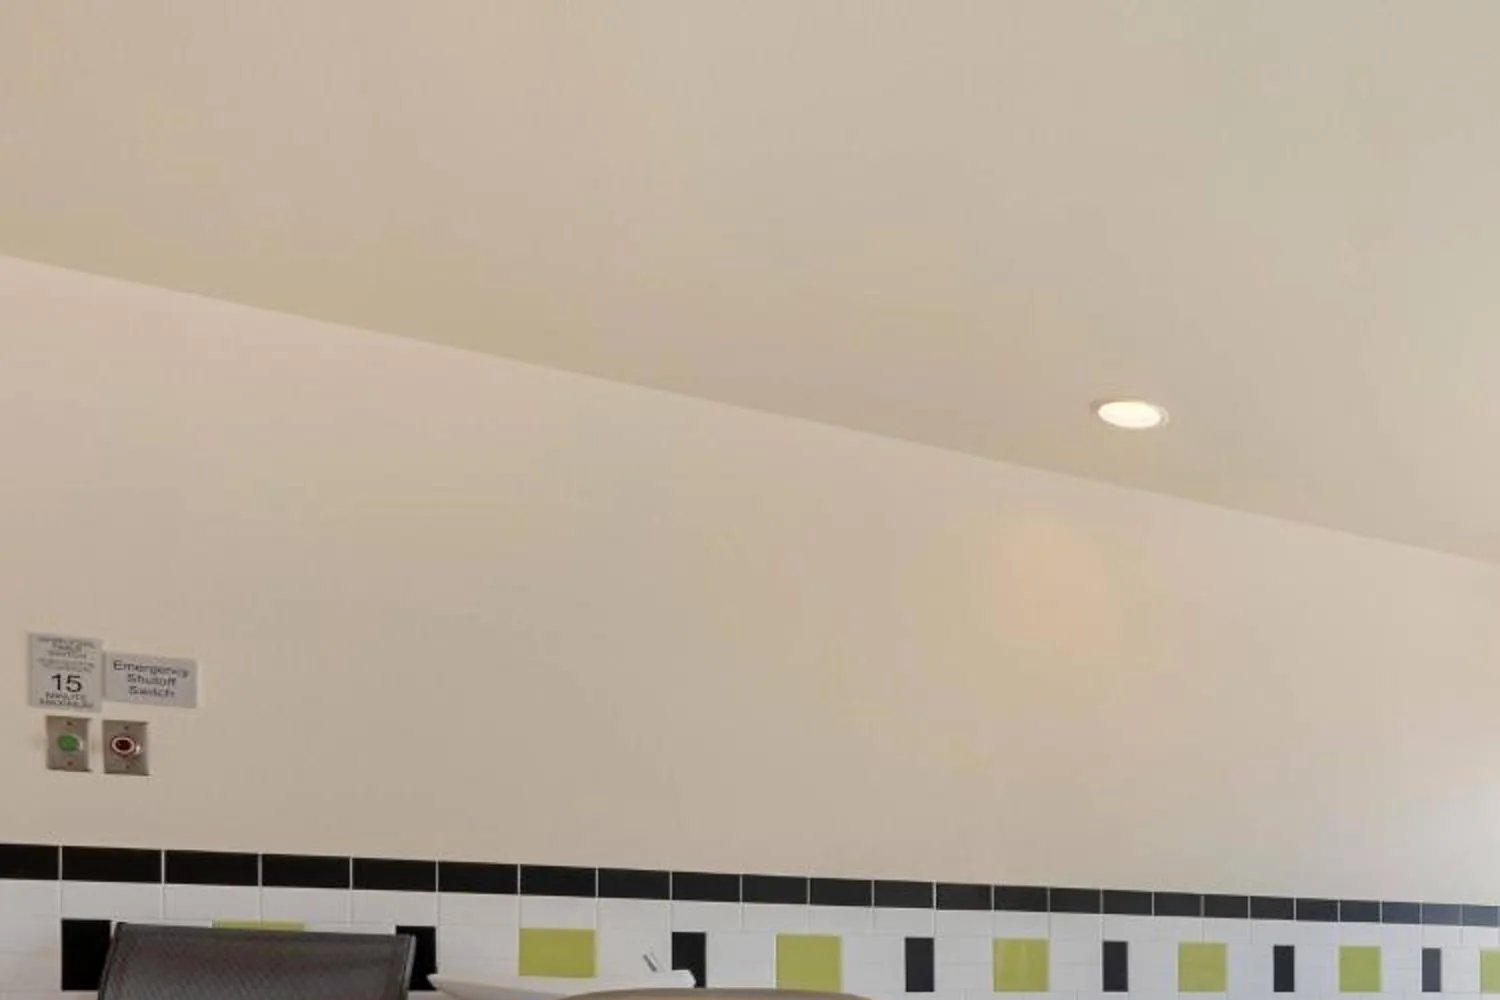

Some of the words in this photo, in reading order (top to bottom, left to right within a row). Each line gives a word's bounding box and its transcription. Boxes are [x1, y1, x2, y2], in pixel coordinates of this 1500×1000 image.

[113, 659, 190, 678] Emergency
[51, 674, 83, 693] 15
[127, 674, 177, 688] Shutoff
[128, 685, 175, 698] Switch
